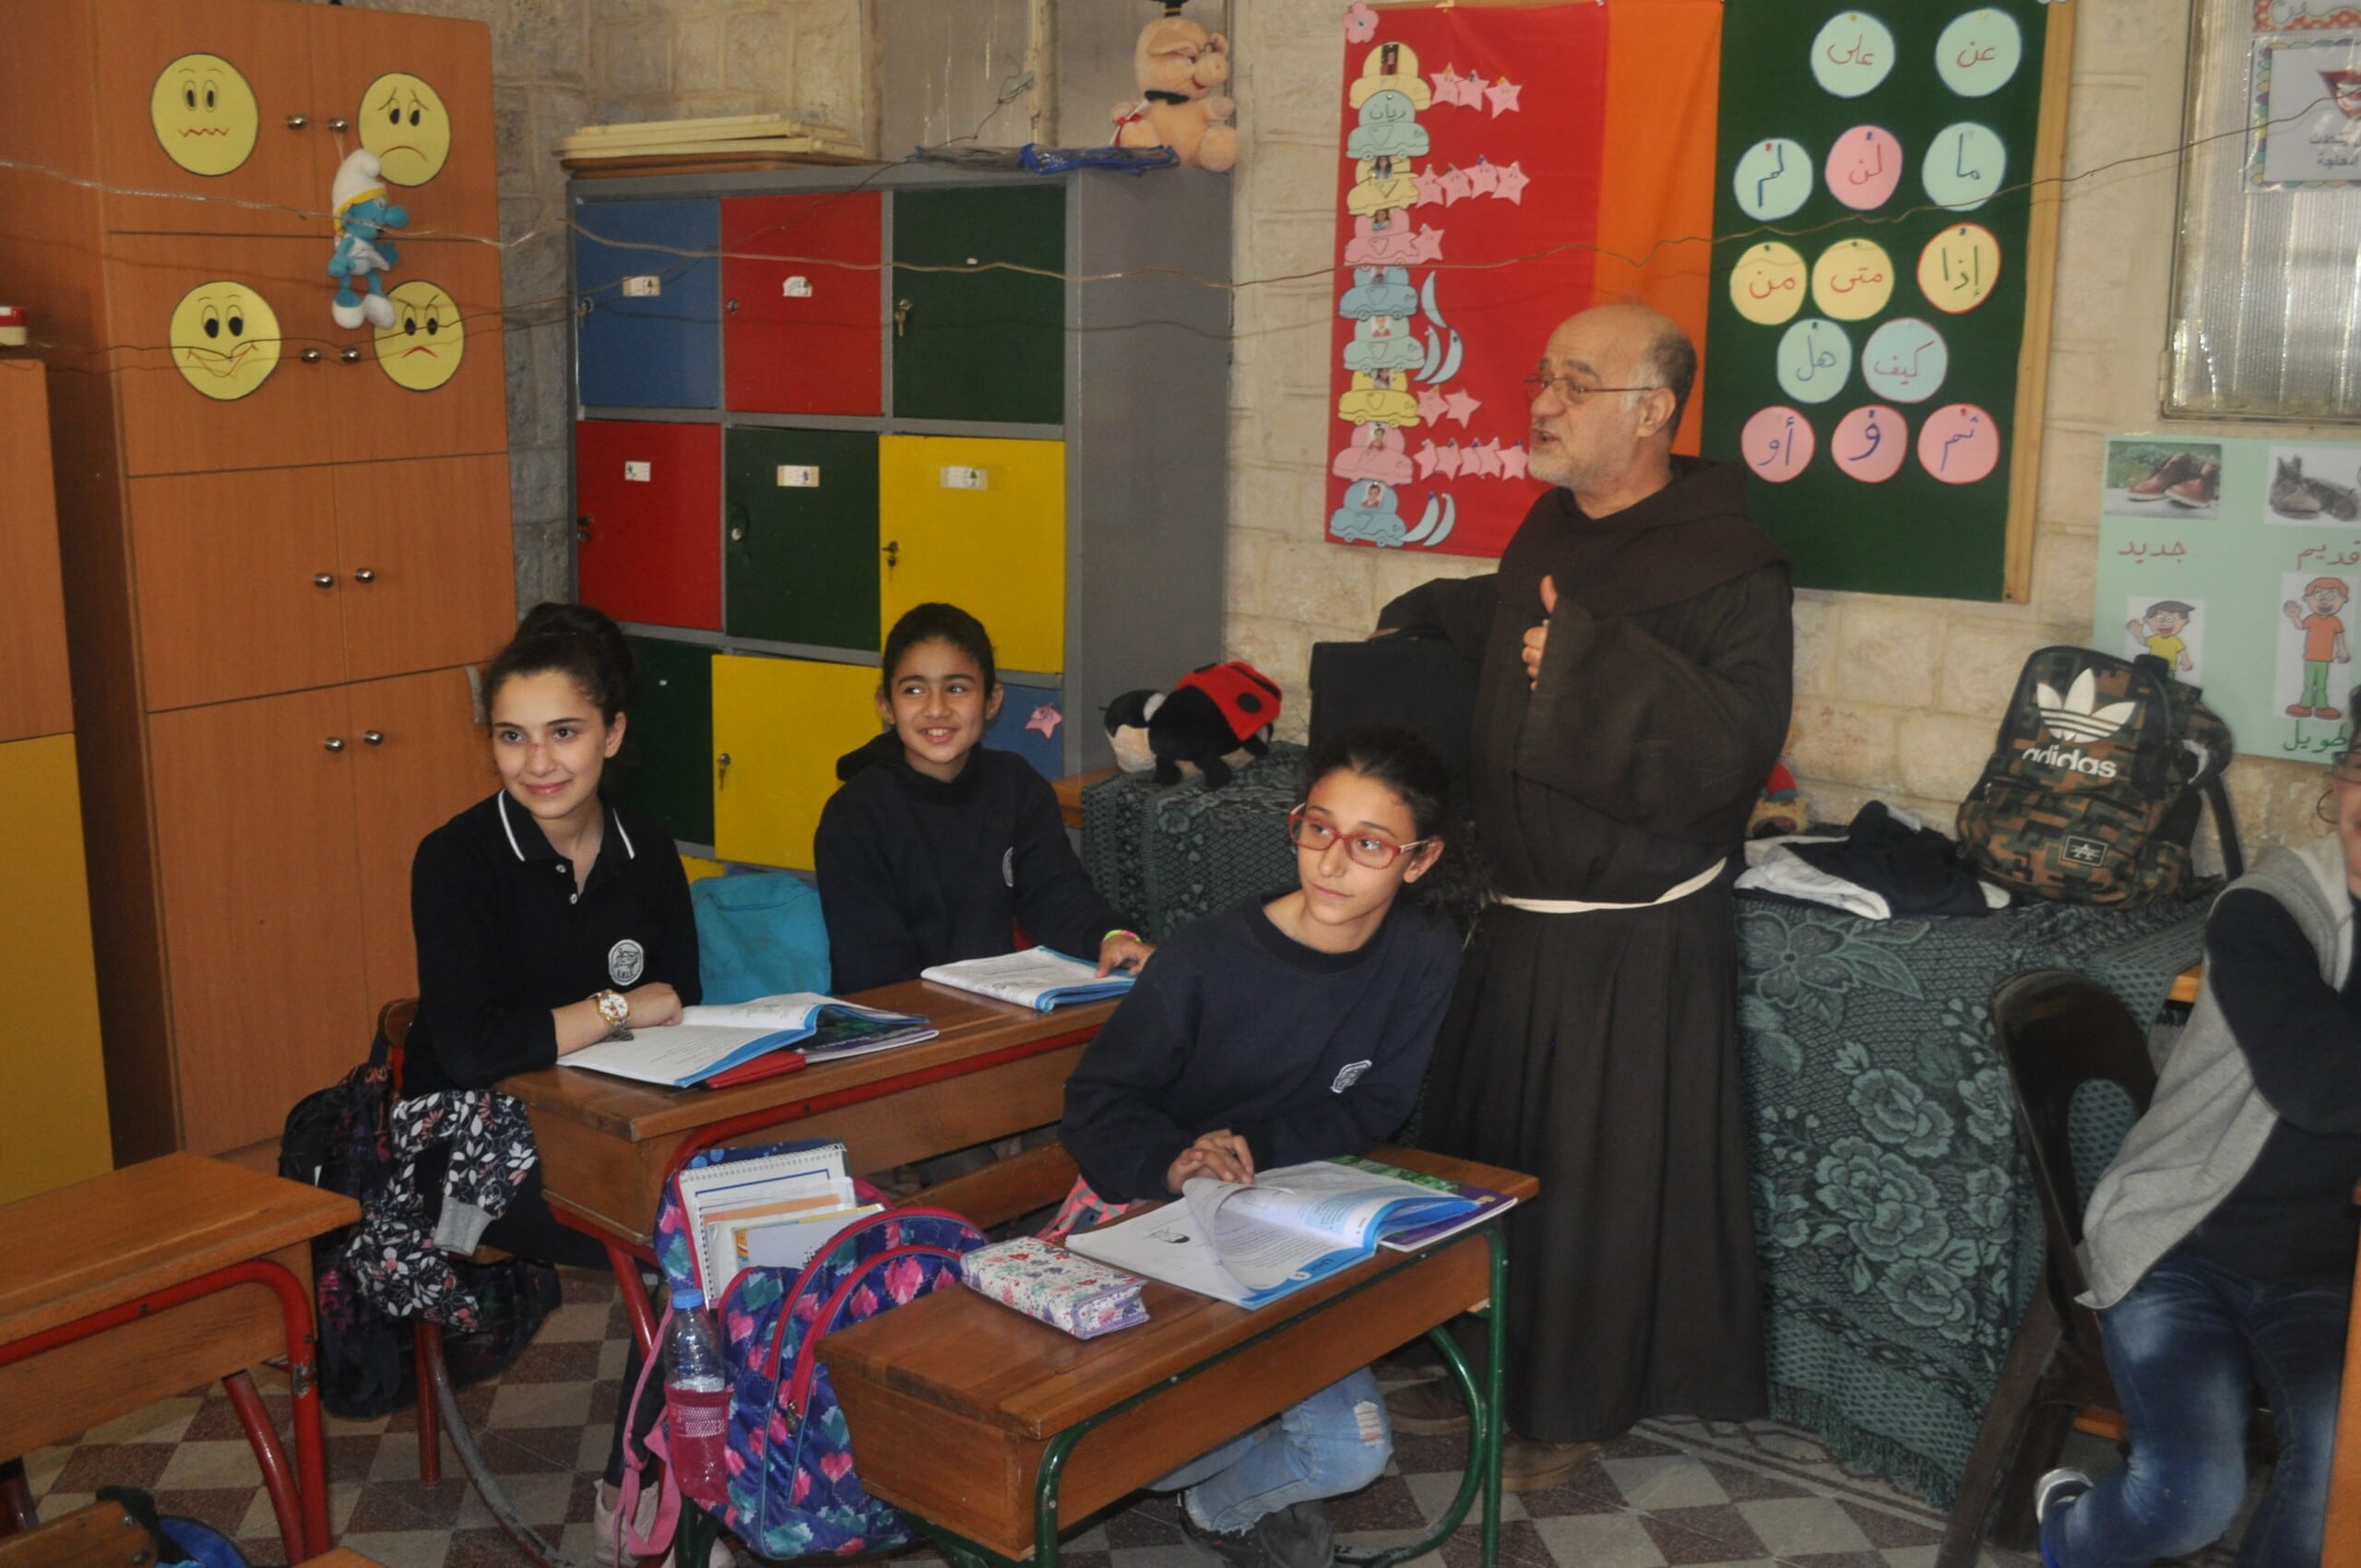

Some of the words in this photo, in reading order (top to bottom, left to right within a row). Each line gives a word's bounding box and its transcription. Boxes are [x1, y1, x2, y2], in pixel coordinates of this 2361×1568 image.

[1956, 42, 1996, 68] عن
[1756, 143, 1785, 208] لم
[1848, 143, 1882, 184] لن
[1956, 132, 1981, 180] ما
[1749, 270, 1797, 300] من
[1796, 335, 1837, 382] هل
[1873, 340, 1935, 386] كيف
[1756, 416, 1795, 468] أو
[1940, 416, 1978, 473] ثم
[2118, 540, 2187, 564] جديد
[2282, 719, 2348, 754] طويل
